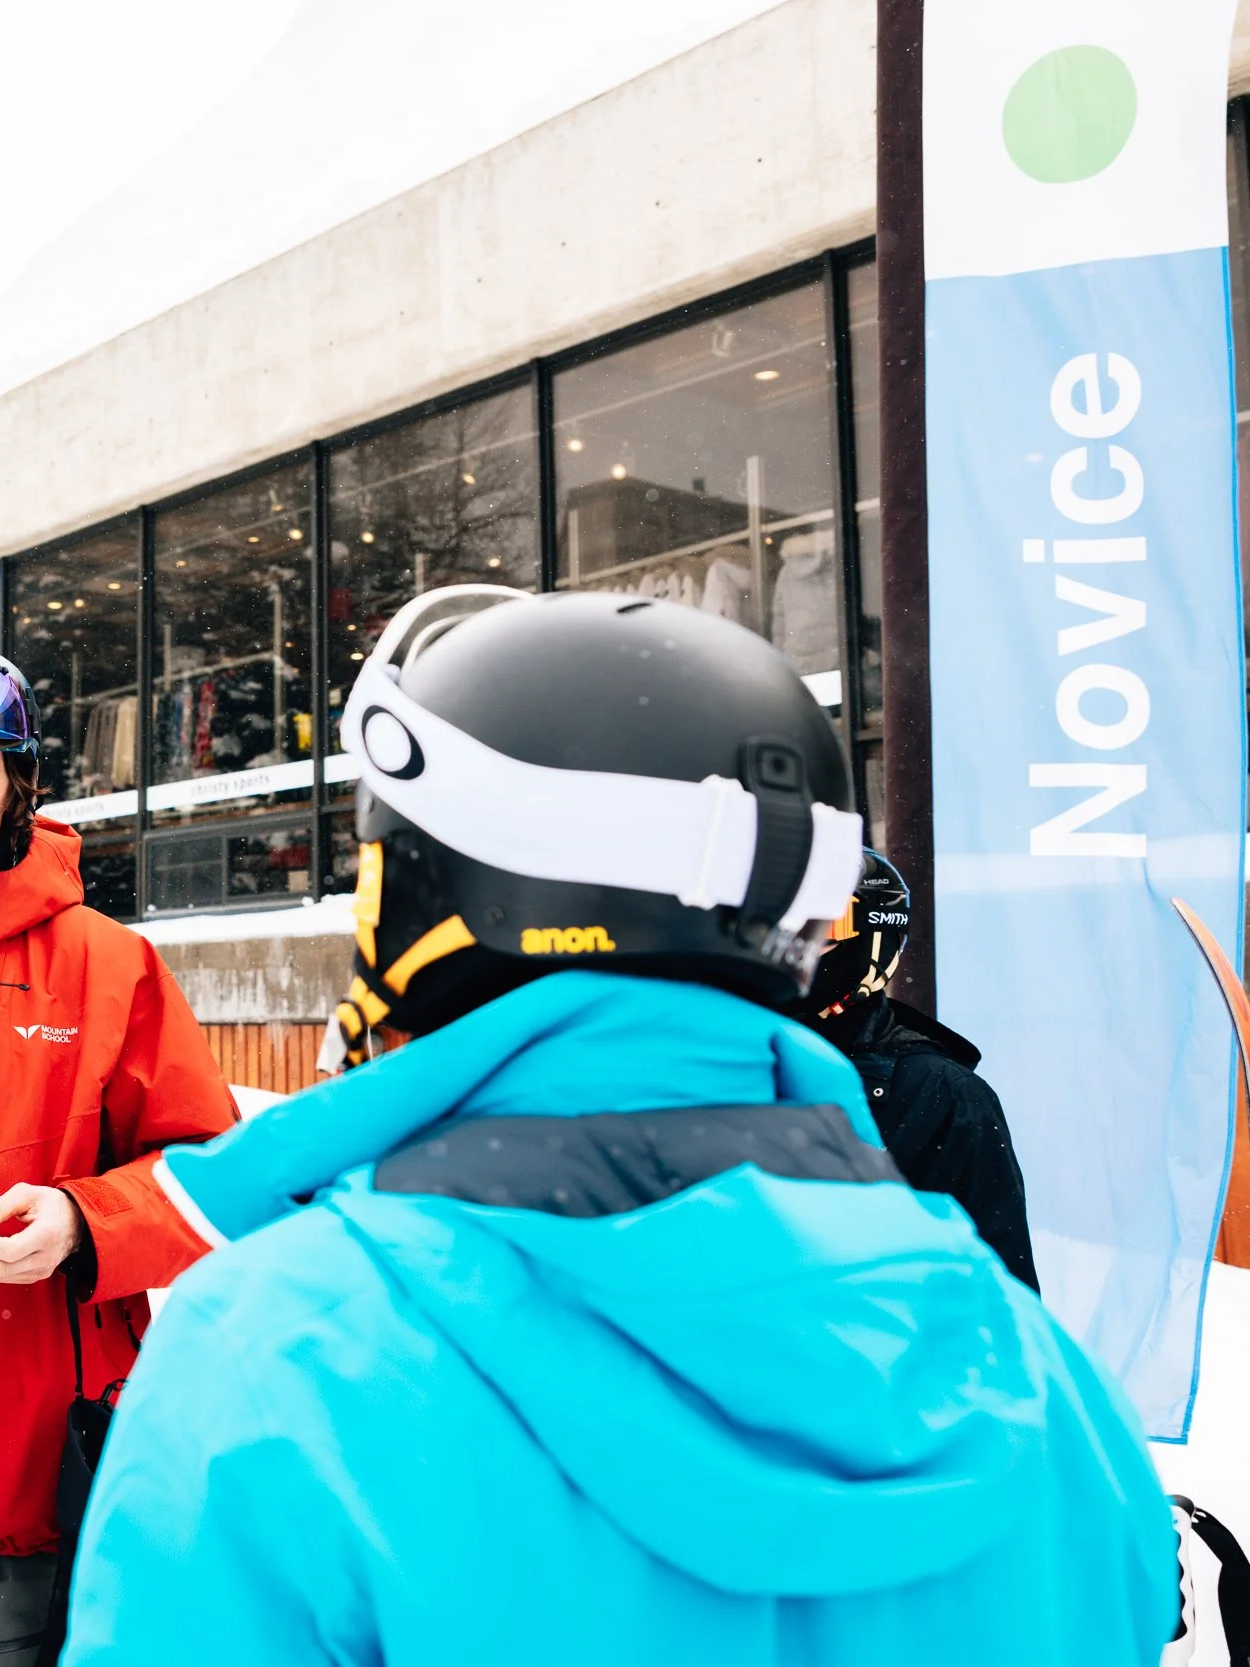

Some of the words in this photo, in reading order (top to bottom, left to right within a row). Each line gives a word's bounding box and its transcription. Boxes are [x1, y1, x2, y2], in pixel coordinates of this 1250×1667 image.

[1023, 351, 1151, 859] Novice
[234, 775, 270, 791] sports
[868, 911, 908, 925] SMITH
[41, 1025, 78, 1036] MOUNTAIN
[41, 1032, 72, 1043] SCHOOL
